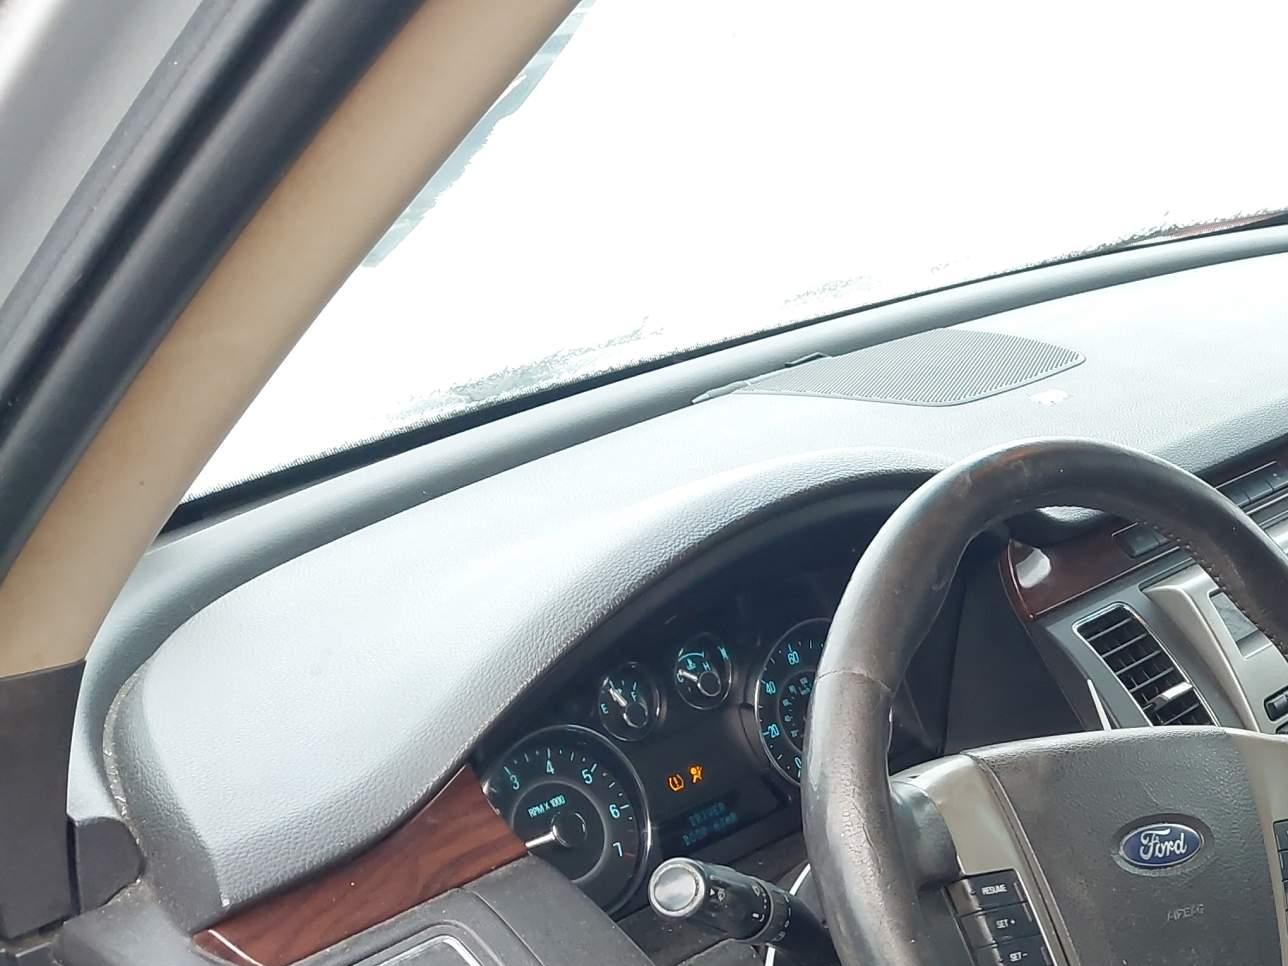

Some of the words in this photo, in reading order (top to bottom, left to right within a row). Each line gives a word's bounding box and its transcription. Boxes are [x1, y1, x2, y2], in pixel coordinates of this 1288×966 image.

[787, 650, 800, 666] 60
[766, 681, 777, 695] 40
[600, 703, 609, 714] E
[768, 724, 780, 738] 20
[546, 760, 555, 775] 4
[509, 774, 520, 790] 3
[581, 768, 593, 785] 5
[528, 802, 545, 818] RPM
[549, 794, 567, 809] 1000
[609, 803, 621, 819] 6
[612, 842, 623, 857] 7
[1139, 827, 1188, 861] Ford
[995, 918, 1009, 929] SET
[1009, 951, 1022, 962] SET
